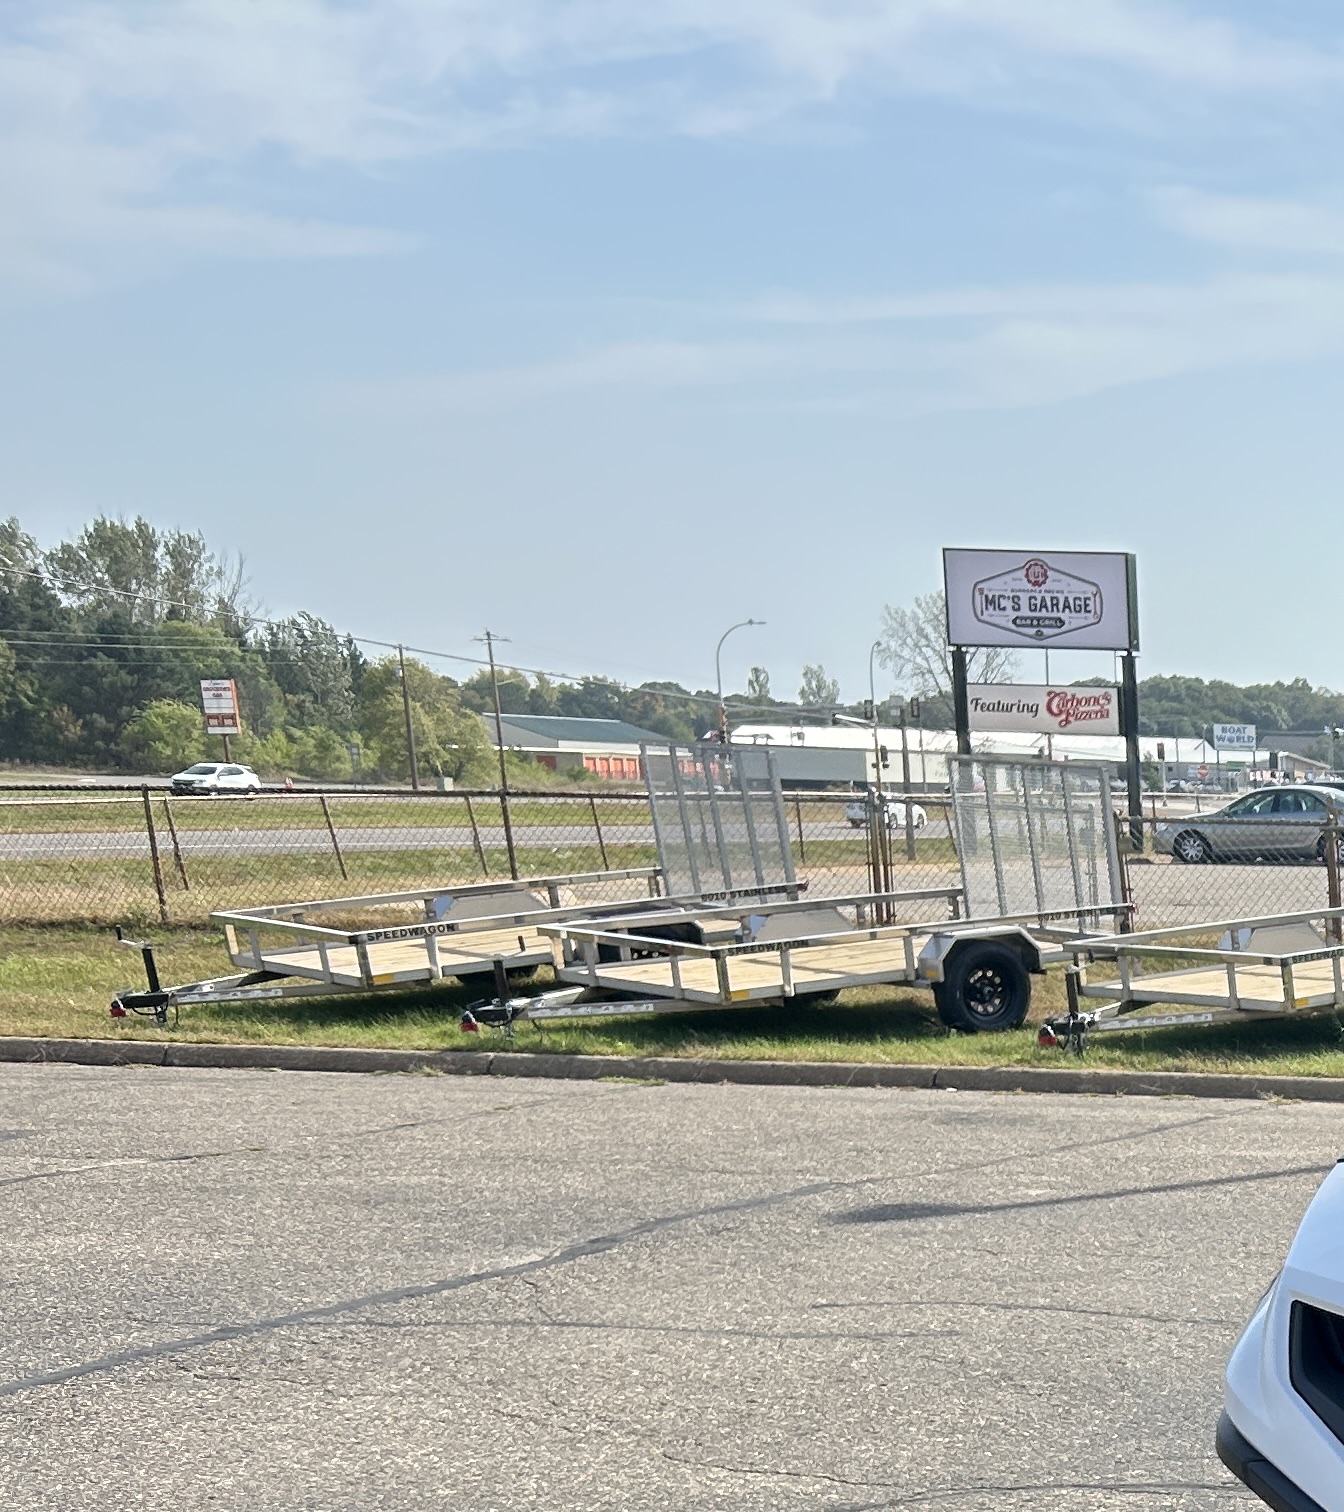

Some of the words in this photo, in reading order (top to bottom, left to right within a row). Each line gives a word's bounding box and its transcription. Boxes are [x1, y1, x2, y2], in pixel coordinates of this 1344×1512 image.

[984, 594, 1021, 612] MC'S
[1028, 595, 1092, 613] GARAGE
[970, 697, 1040, 718] Featuring
[1215, 734, 1255, 744] WORLD
[1221, 726, 1248, 735] BOAT
[367, 923, 456, 941] SPEEDWAGON
[727, 940, 810, 957] SPEEDWAGON
